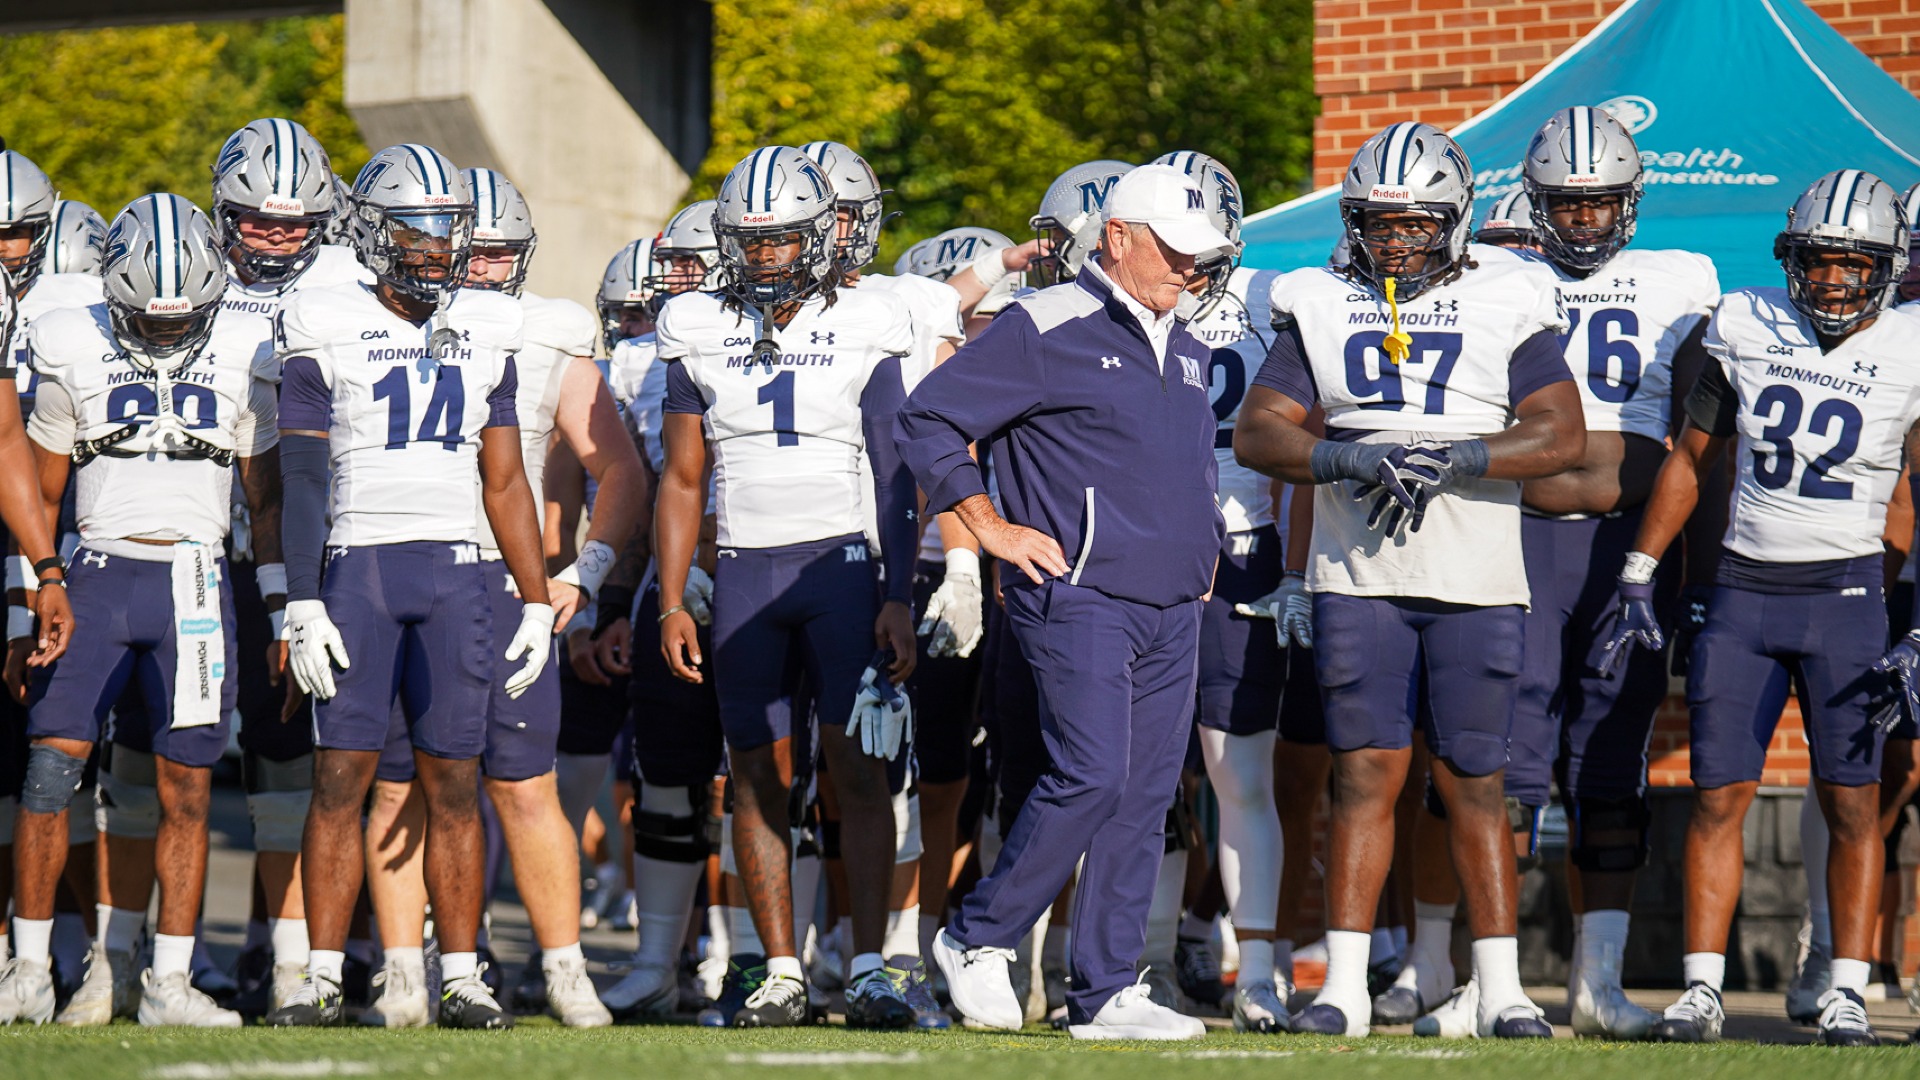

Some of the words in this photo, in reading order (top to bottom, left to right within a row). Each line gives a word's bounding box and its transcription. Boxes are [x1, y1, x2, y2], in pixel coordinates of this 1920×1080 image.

[1642, 169, 1780, 185] Institute
[425, 196, 455, 204] Riddell
[1076, 173, 1126, 215] M
[1185, 187, 1205, 210] M
[1373, 189, 1409, 199] Riddell
[266, 201, 302, 211] Riddell
[744, 215, 774, 223] Riddell
[936, 236, 979, 266] M
[151, 303, 188, 311] Riddell
[220, 300, 279, 314] NMOU
[361, 330, 390, 340] CAA
[724, 337, 752, 347] CAA
[1766, 344, 1794, 356] CAA
[726, 353, 834, 368] MOOUTH
[1174, 353, 1202, 383] M
[1344, 330, 1463, 414] 97
[1766, 363, 1871, 398] MONMOUTH
[372, 365, 466, 452] 14
[757, 370, 799, 447] 1
[1750, 384, 1863, 500] 32
[449, 544, 479, 565] M
[843, 545, 867, 563] M
[194, 550, 205, 610] POWERADE
[198, 641, 210, 701] POWERADE
